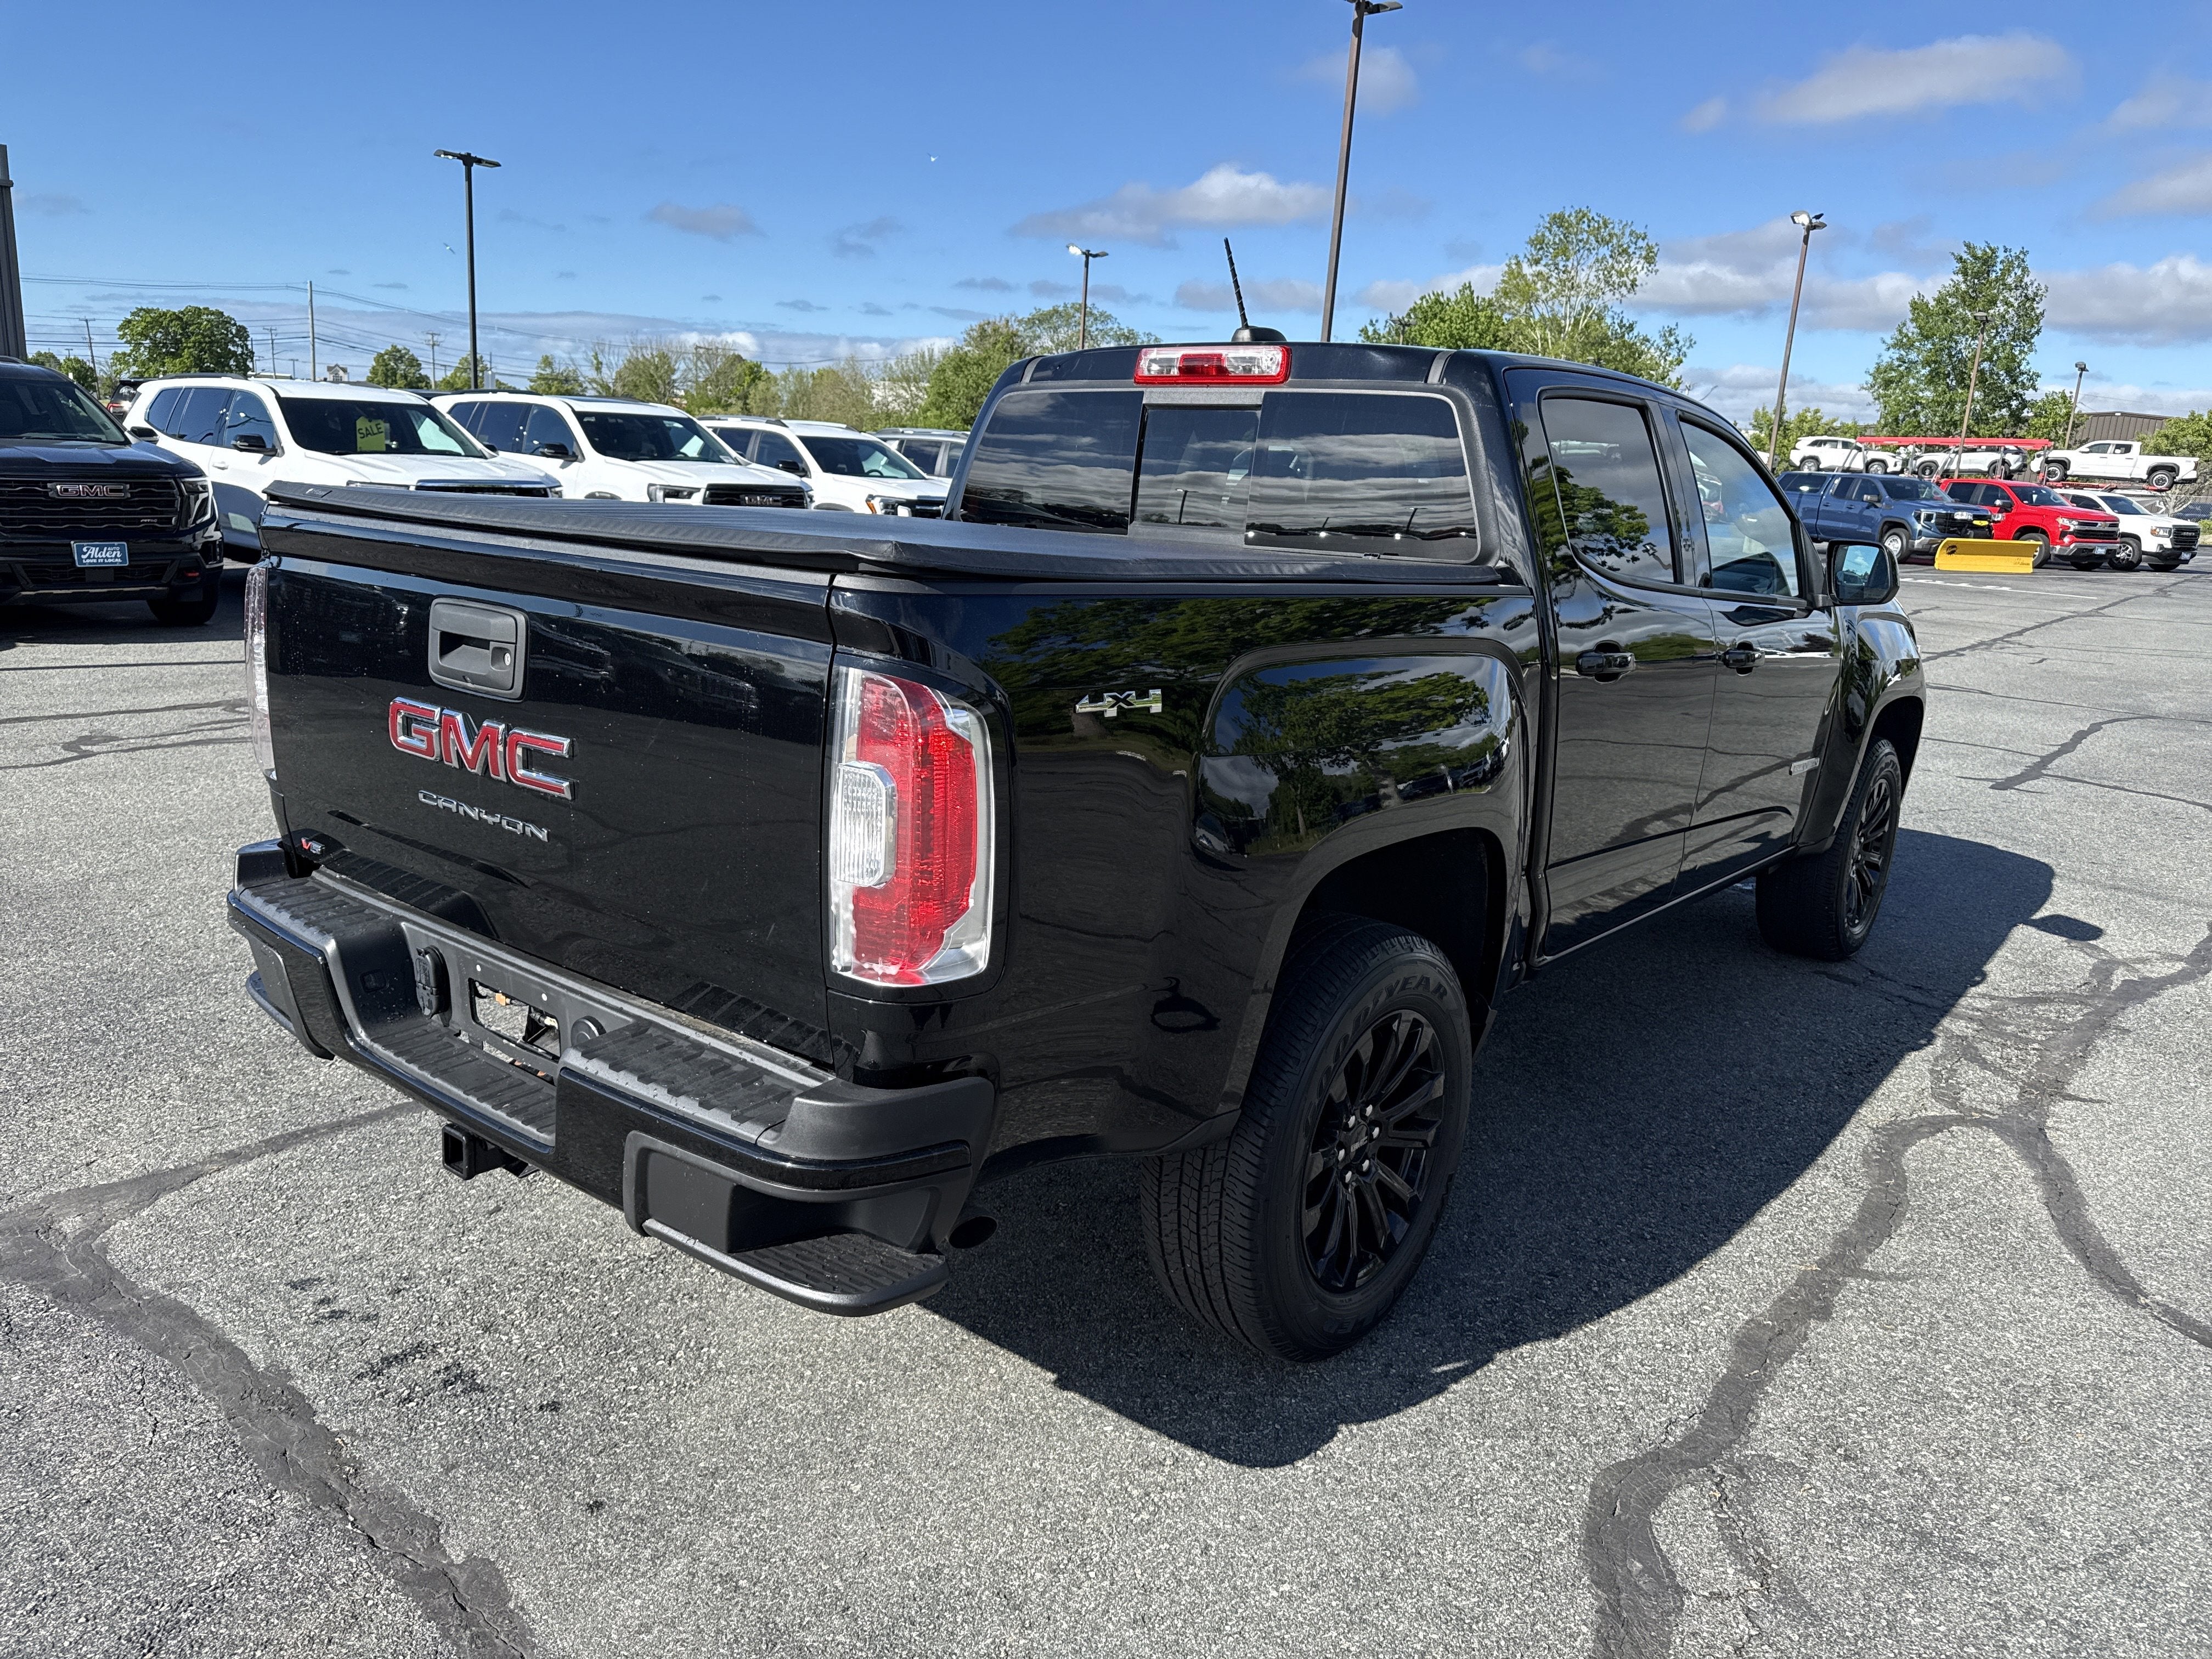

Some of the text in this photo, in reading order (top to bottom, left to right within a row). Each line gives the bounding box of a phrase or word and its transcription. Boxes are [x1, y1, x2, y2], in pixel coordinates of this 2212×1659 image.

[358, 423, 383, 439] SALE
[57, 484, 124, 496] GMC
[81, 546, 122, 558] Alden
[388, 697, 573, 800] GMC
[419, 790, 549, 842] CANYON
